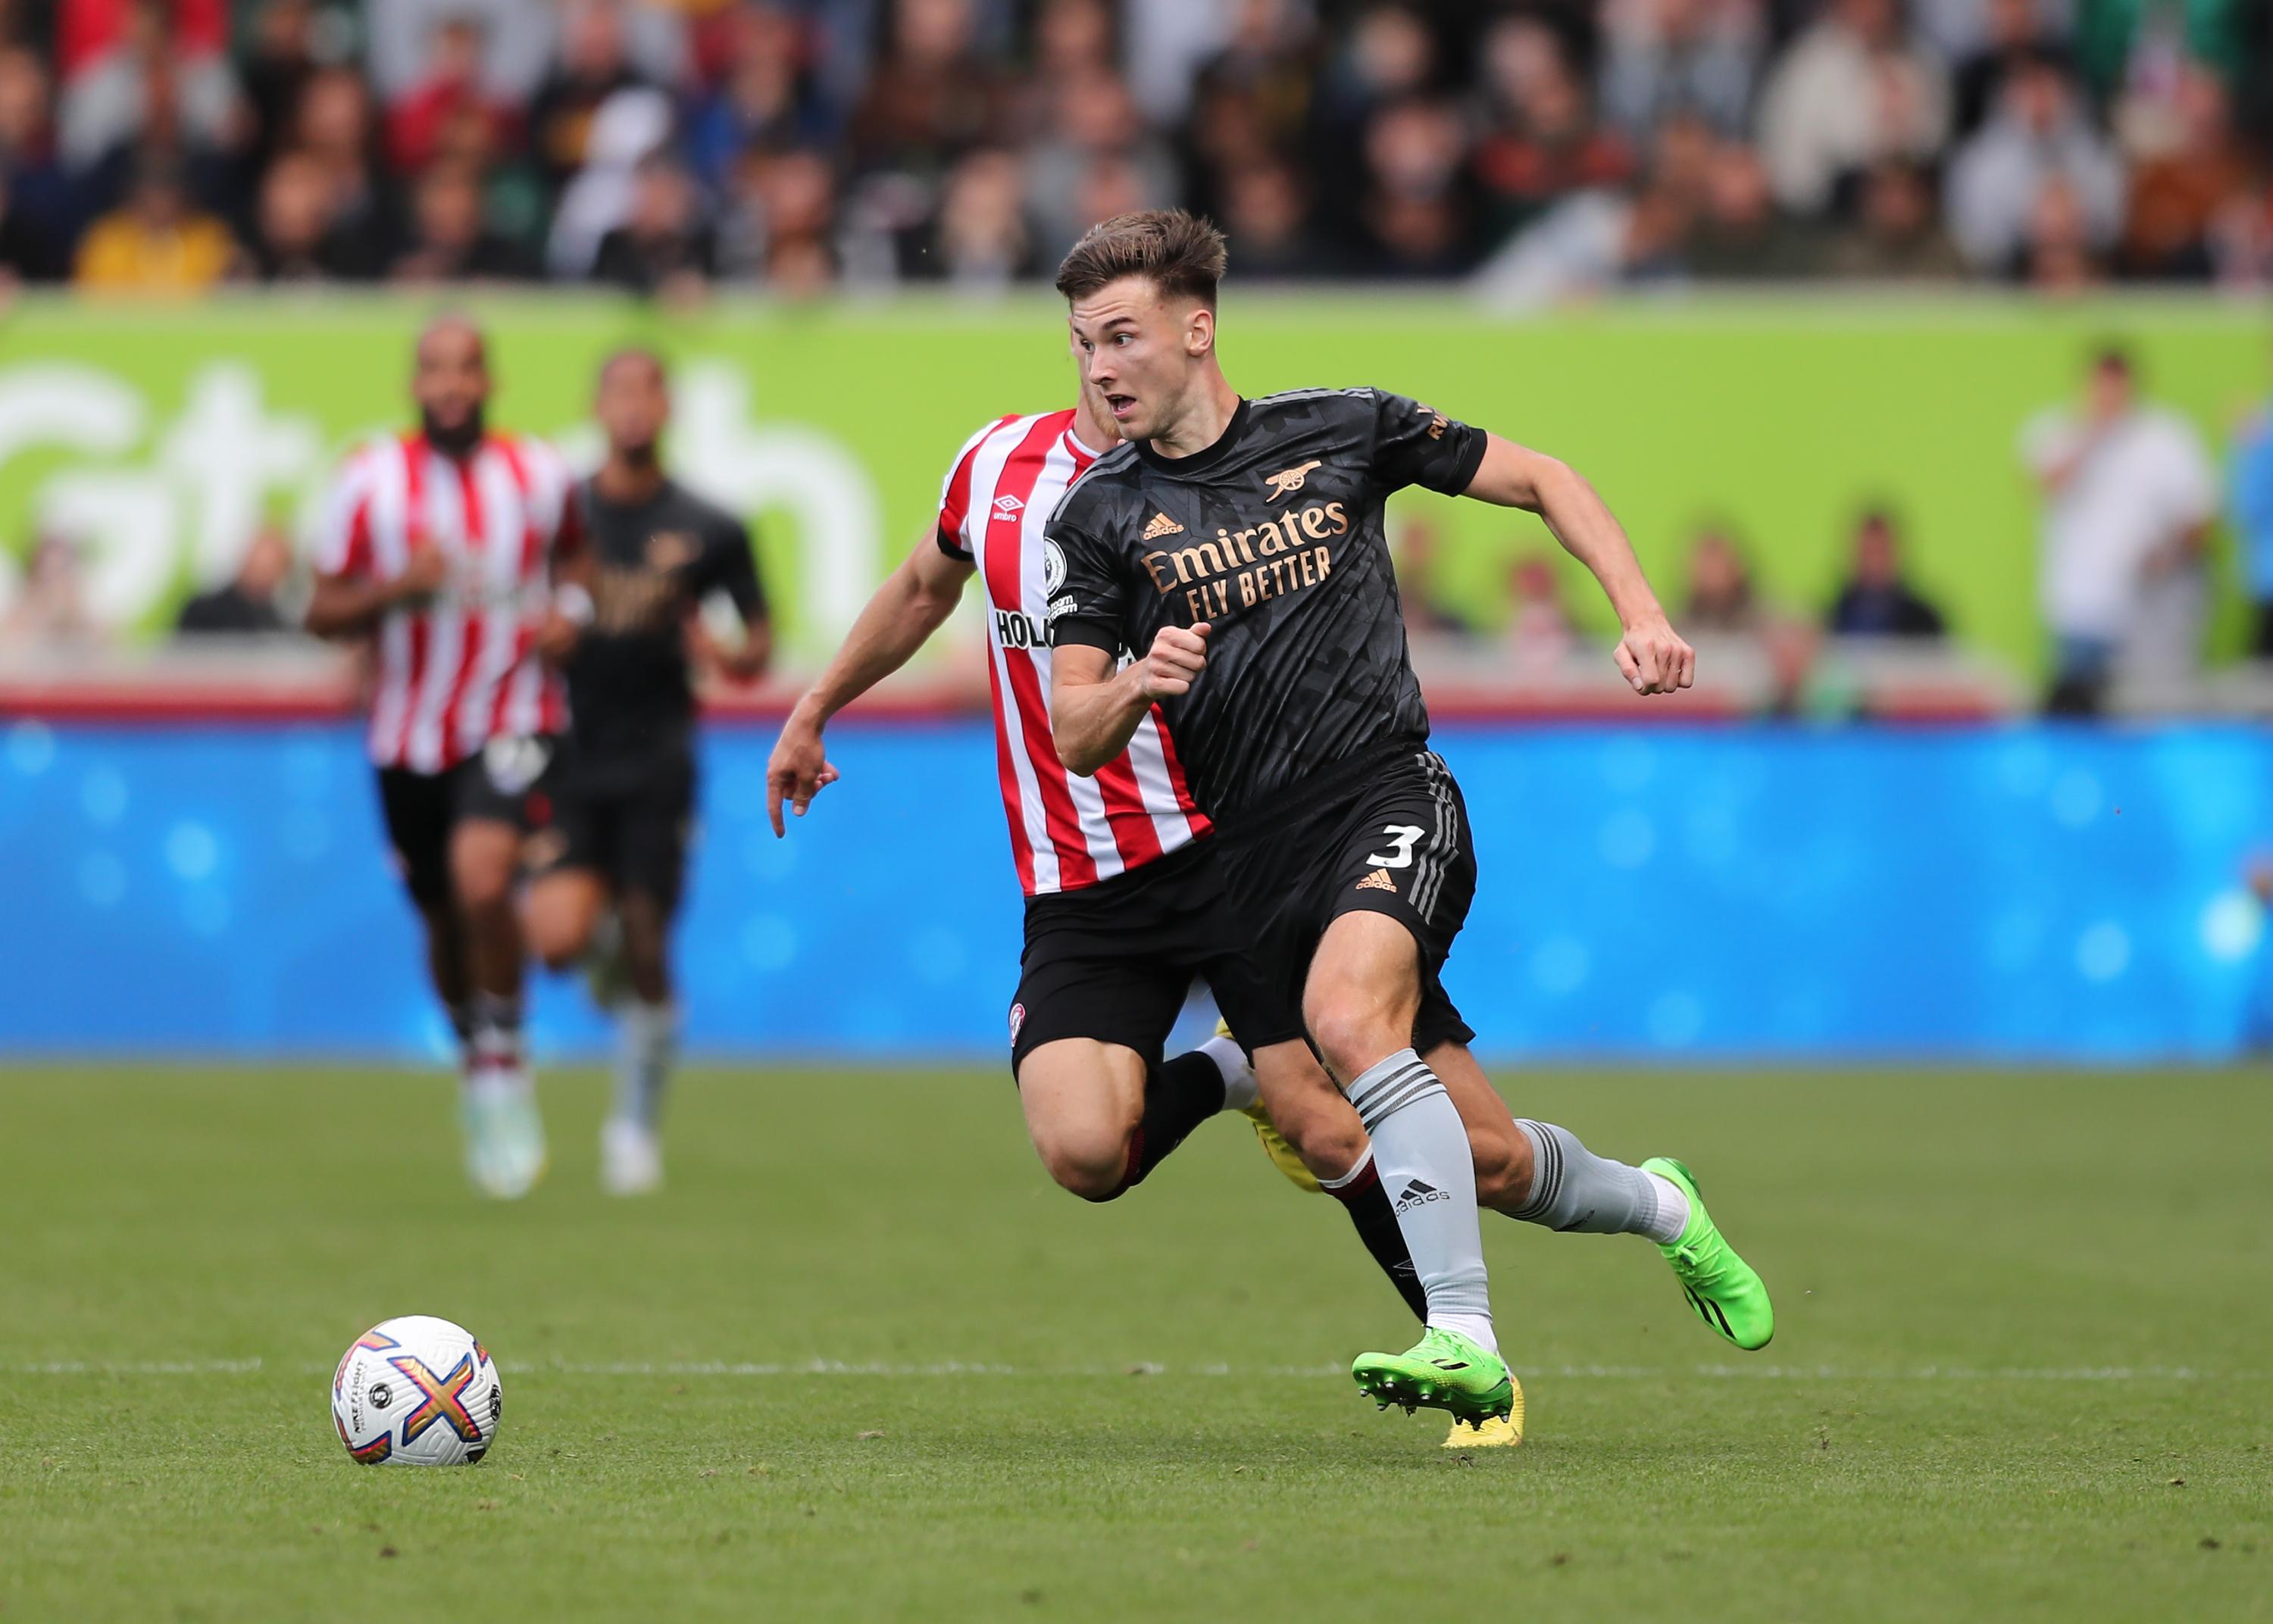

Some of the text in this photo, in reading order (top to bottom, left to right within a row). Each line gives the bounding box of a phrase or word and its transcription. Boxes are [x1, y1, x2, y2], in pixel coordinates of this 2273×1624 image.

[0, 360, 883, 645] Gth
[993, 512, 1017, 522] umbro
[1140, 502, 1349, 595] Emirates
[1143, 524, 1184, 540] adidas
[1186, 546, 1332, 622] FLY BETTER
[1051, 595, 1074, 612] room
[1365, 824, 1425, 869] 3
[1355, 881, 1397, 893] adidas
[1395, 1191, 1450, 1217] adidas
[351, 1359, 364, 1435] NIKE FLIGHT
